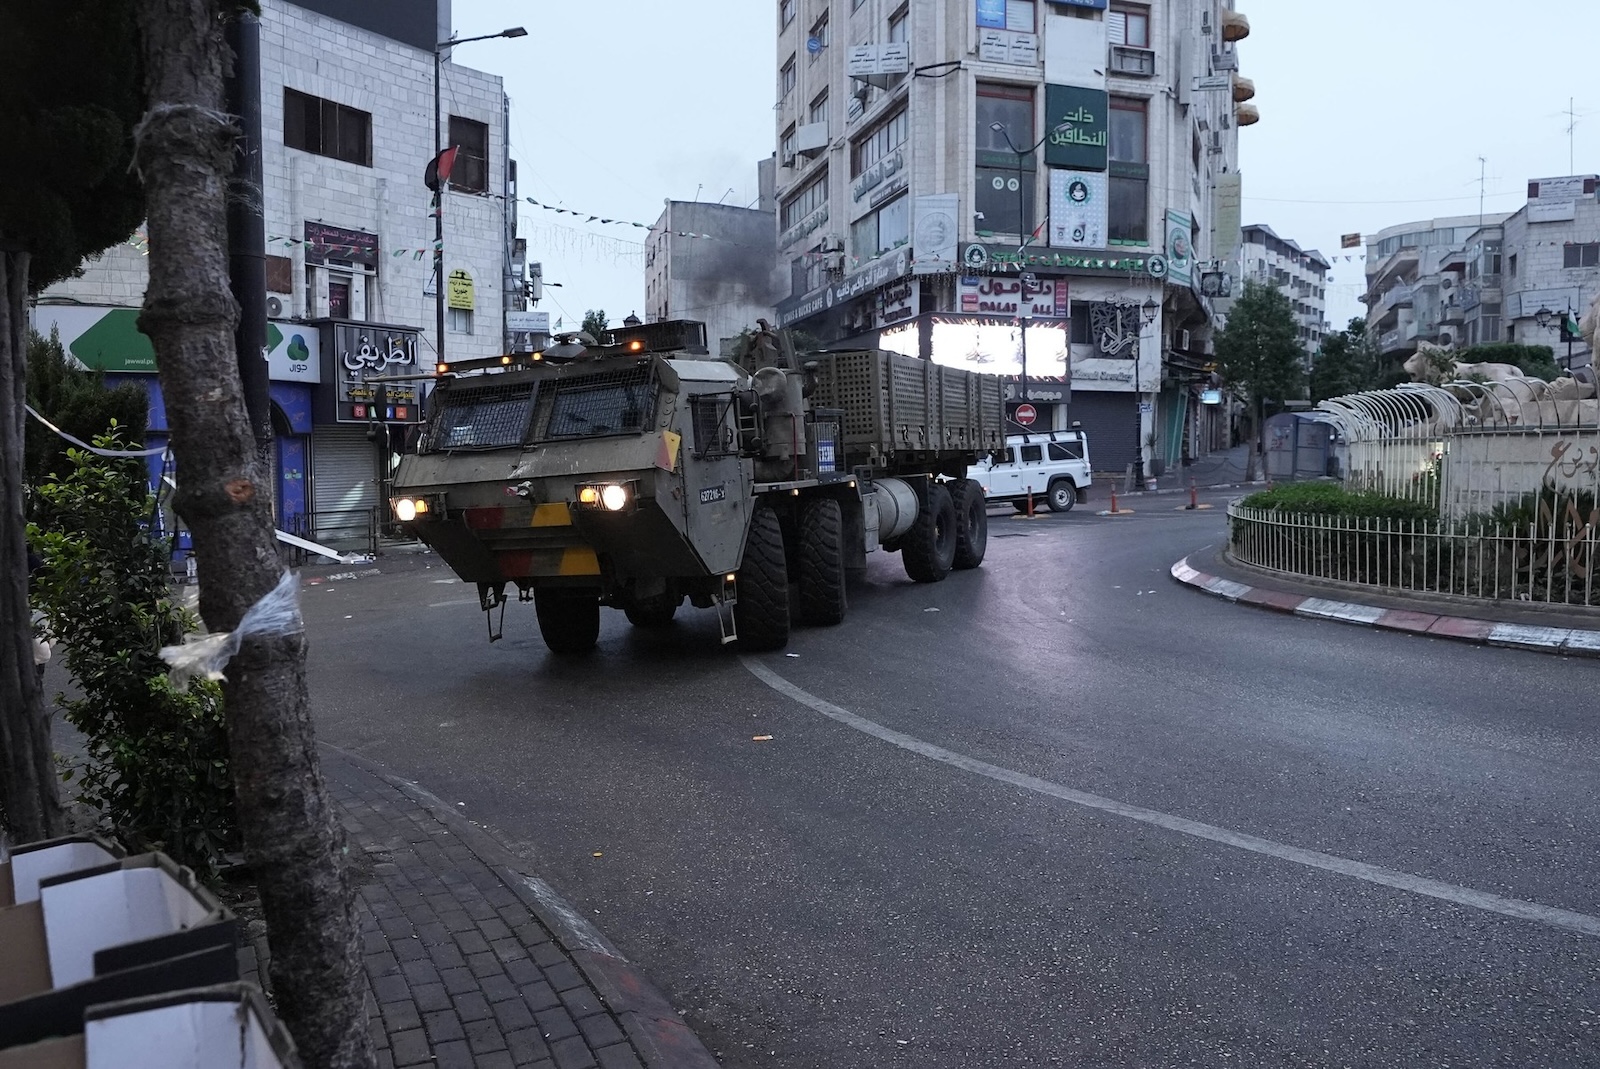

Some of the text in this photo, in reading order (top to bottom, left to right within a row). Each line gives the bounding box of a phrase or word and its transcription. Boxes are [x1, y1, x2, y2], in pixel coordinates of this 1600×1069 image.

[1063, 106, 1094, 123] ذات
[1050, 128, 1107, 147] النطاقين
[980, 279, 1020, 296] مول
[1031, 303, 1053, 316] ALL
[124, 358, 154, 366] jawwal.ps
[289, 364, 308, 373] جوال
